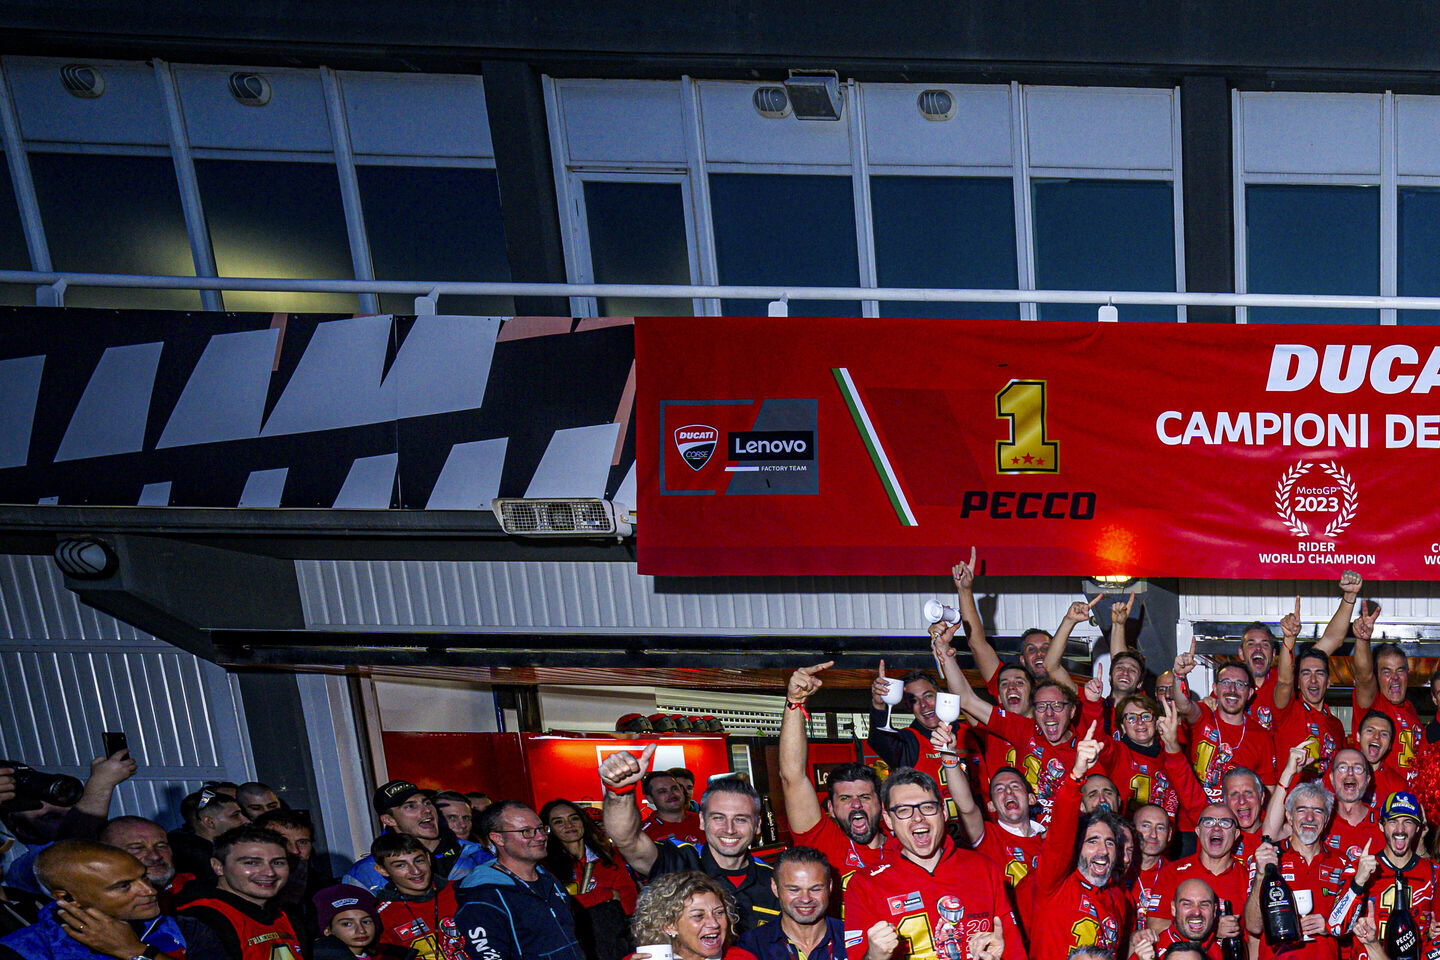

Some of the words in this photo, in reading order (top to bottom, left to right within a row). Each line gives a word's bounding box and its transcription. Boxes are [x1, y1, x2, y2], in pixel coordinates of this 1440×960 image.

[679, 431, 714, 439] DUCATI
[1156, 411, 1368, 448] CAMPIONI
[736, 438, 807, 453] Lenovo
[960, 491, 1096, 520] PECCO
[1294, 497, 1339, 512] 2023
[1298, 541, 1336, 552] RIDER
[1259, 553, 1305, 564] WORLD
[1308, 553, 1376, 565] CHAMPION
[1395, 931, 1413, 947] PECCO
